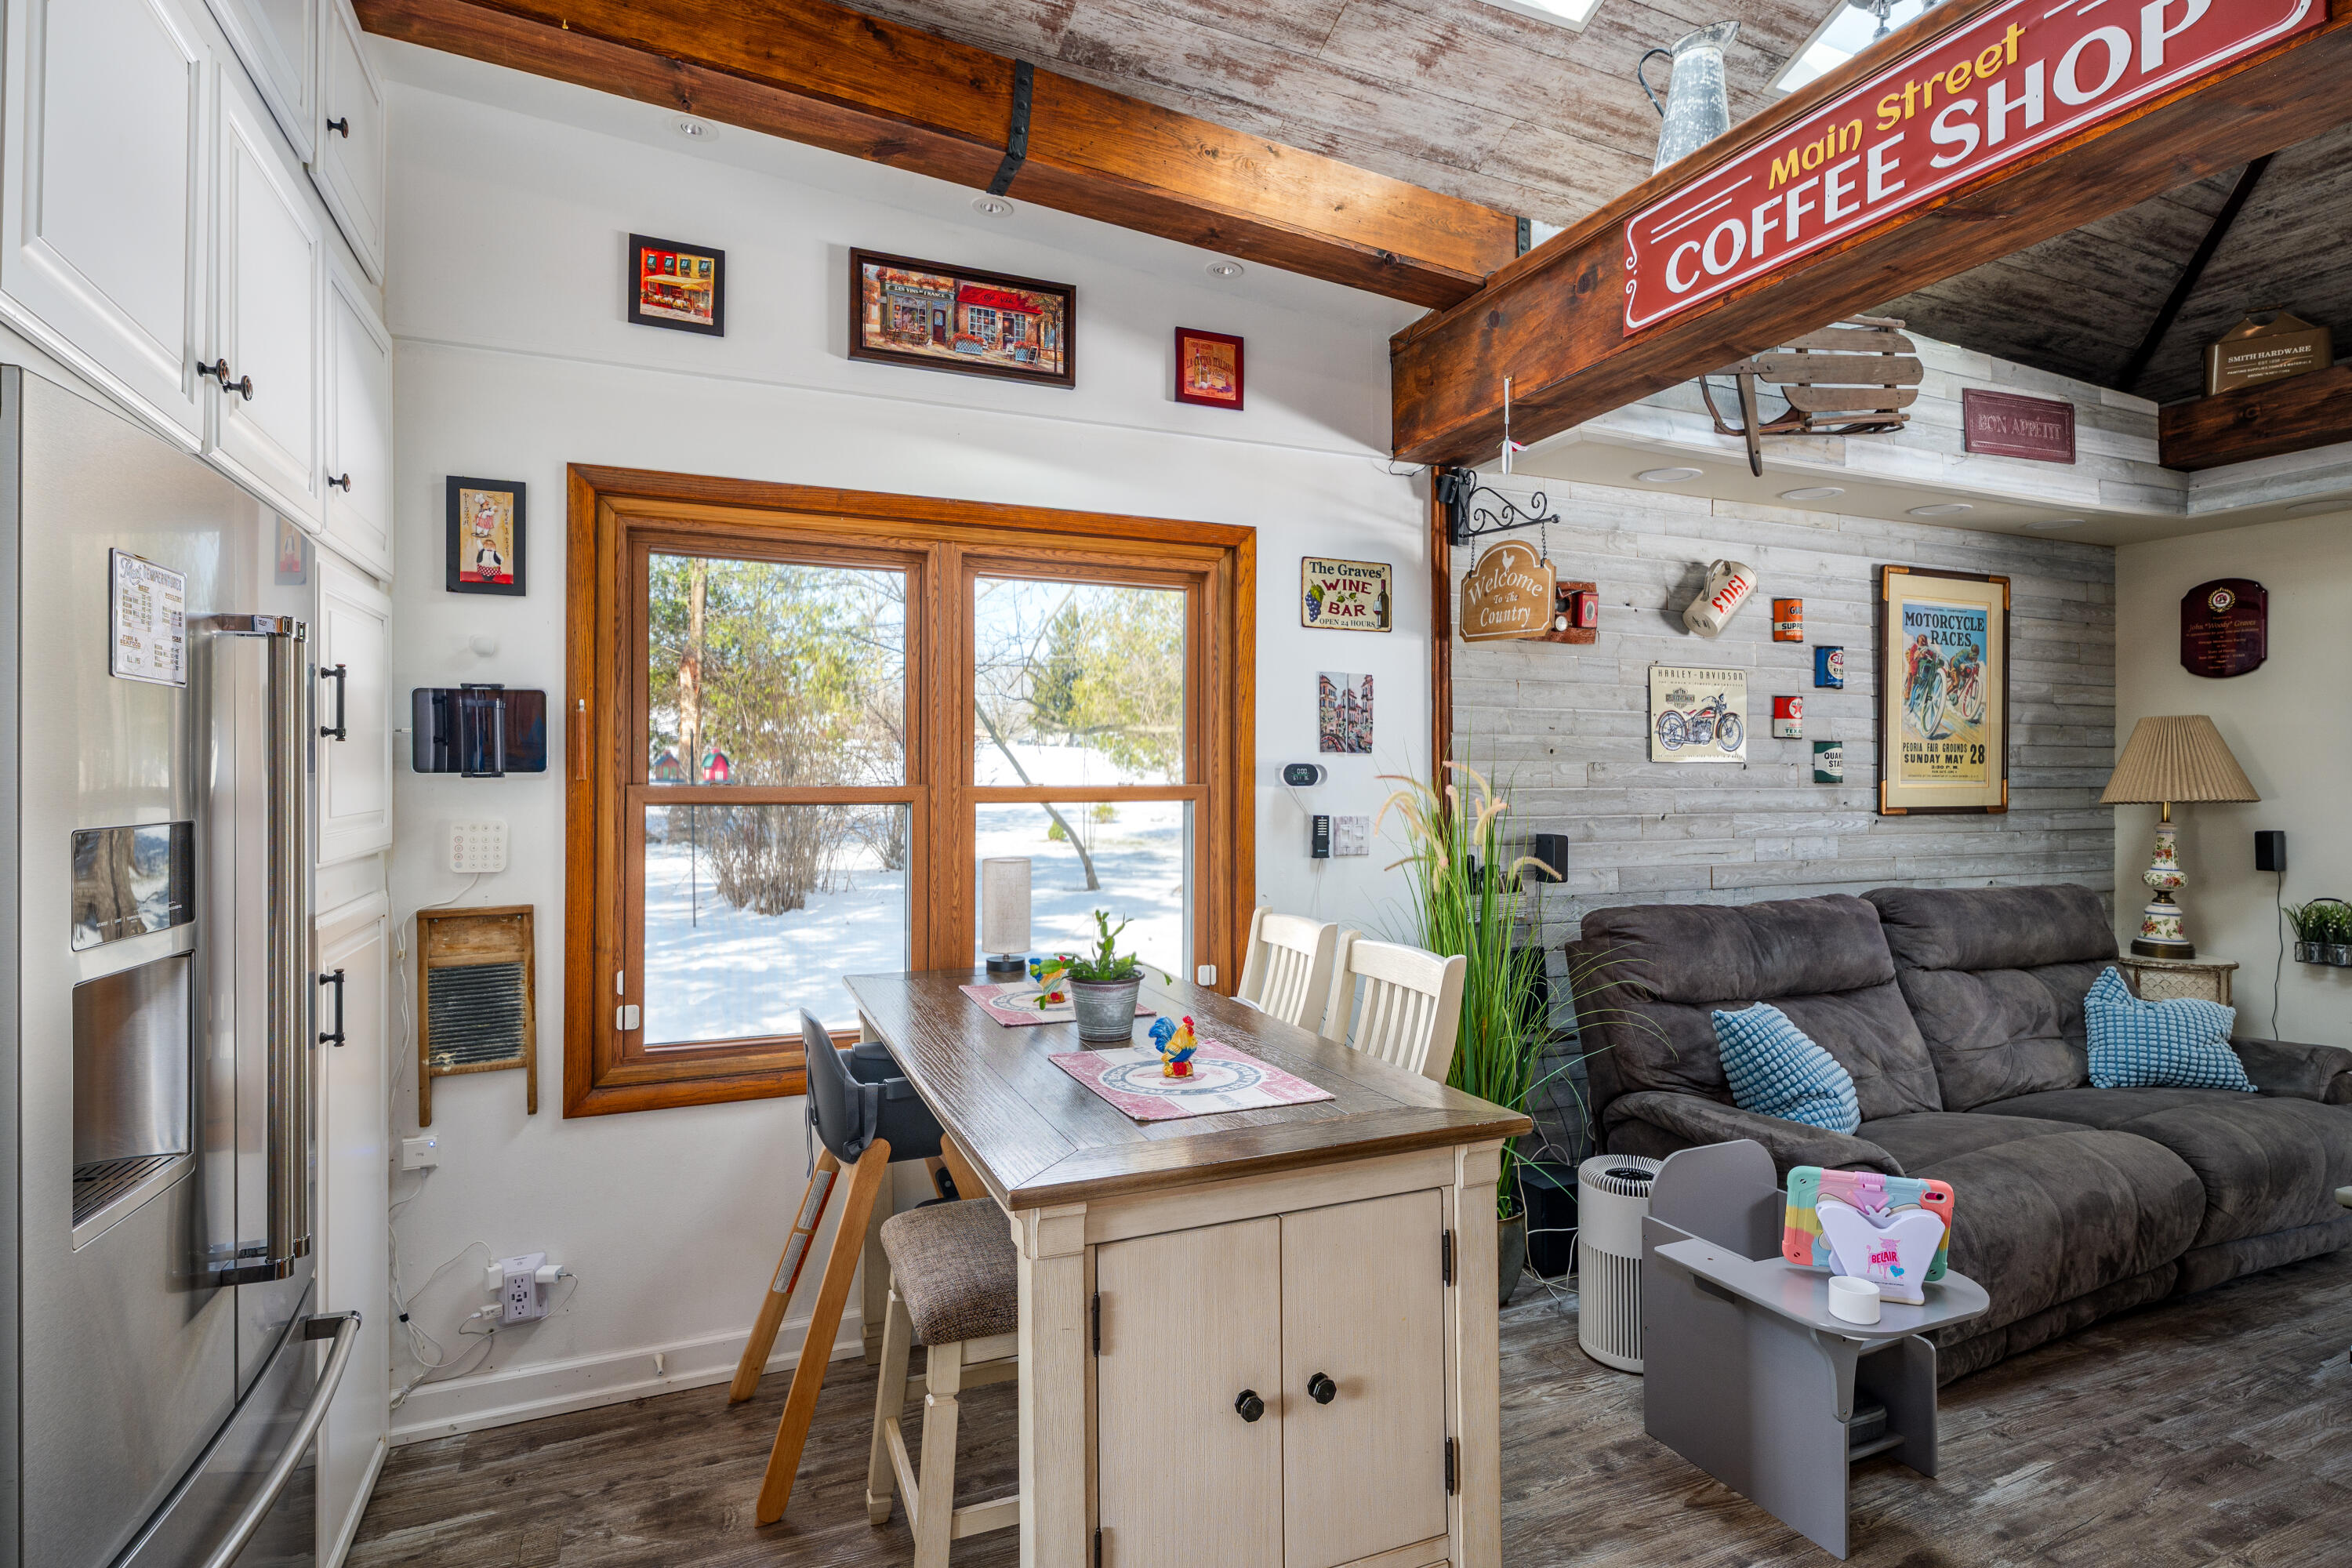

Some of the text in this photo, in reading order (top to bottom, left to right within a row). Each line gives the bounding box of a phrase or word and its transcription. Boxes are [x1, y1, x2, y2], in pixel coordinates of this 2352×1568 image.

[1769, 21, 2027, 191] Main Street
[1665, 0, 2212, 293] COFFEE SHOP
[2228, 345, 2311, 364] SMITH HARDWARE
[1977, 414, 2007, 434] BON
[1309, 561, 1385, 579] The Graves'
[1321, 579, 1373, 594] WINE
[1468, 568, 1543, 606] Welcome
[1494, 590, 1519, 604] To The
[1327, 601, 1367, 616] BAR
[1480, 605, 1531, 628] Country
[1904, 612, 1984, 632] MOTORCYCLE
[1930, 630, 1972, 647] RACES
[1902, 742, 1967, 753] PEORIA FAIR GROUNDS
[1904, 744, 1985, 764] SUNDAY MAY 28
[1871, 1250, 1899, 1264] BELAIR
